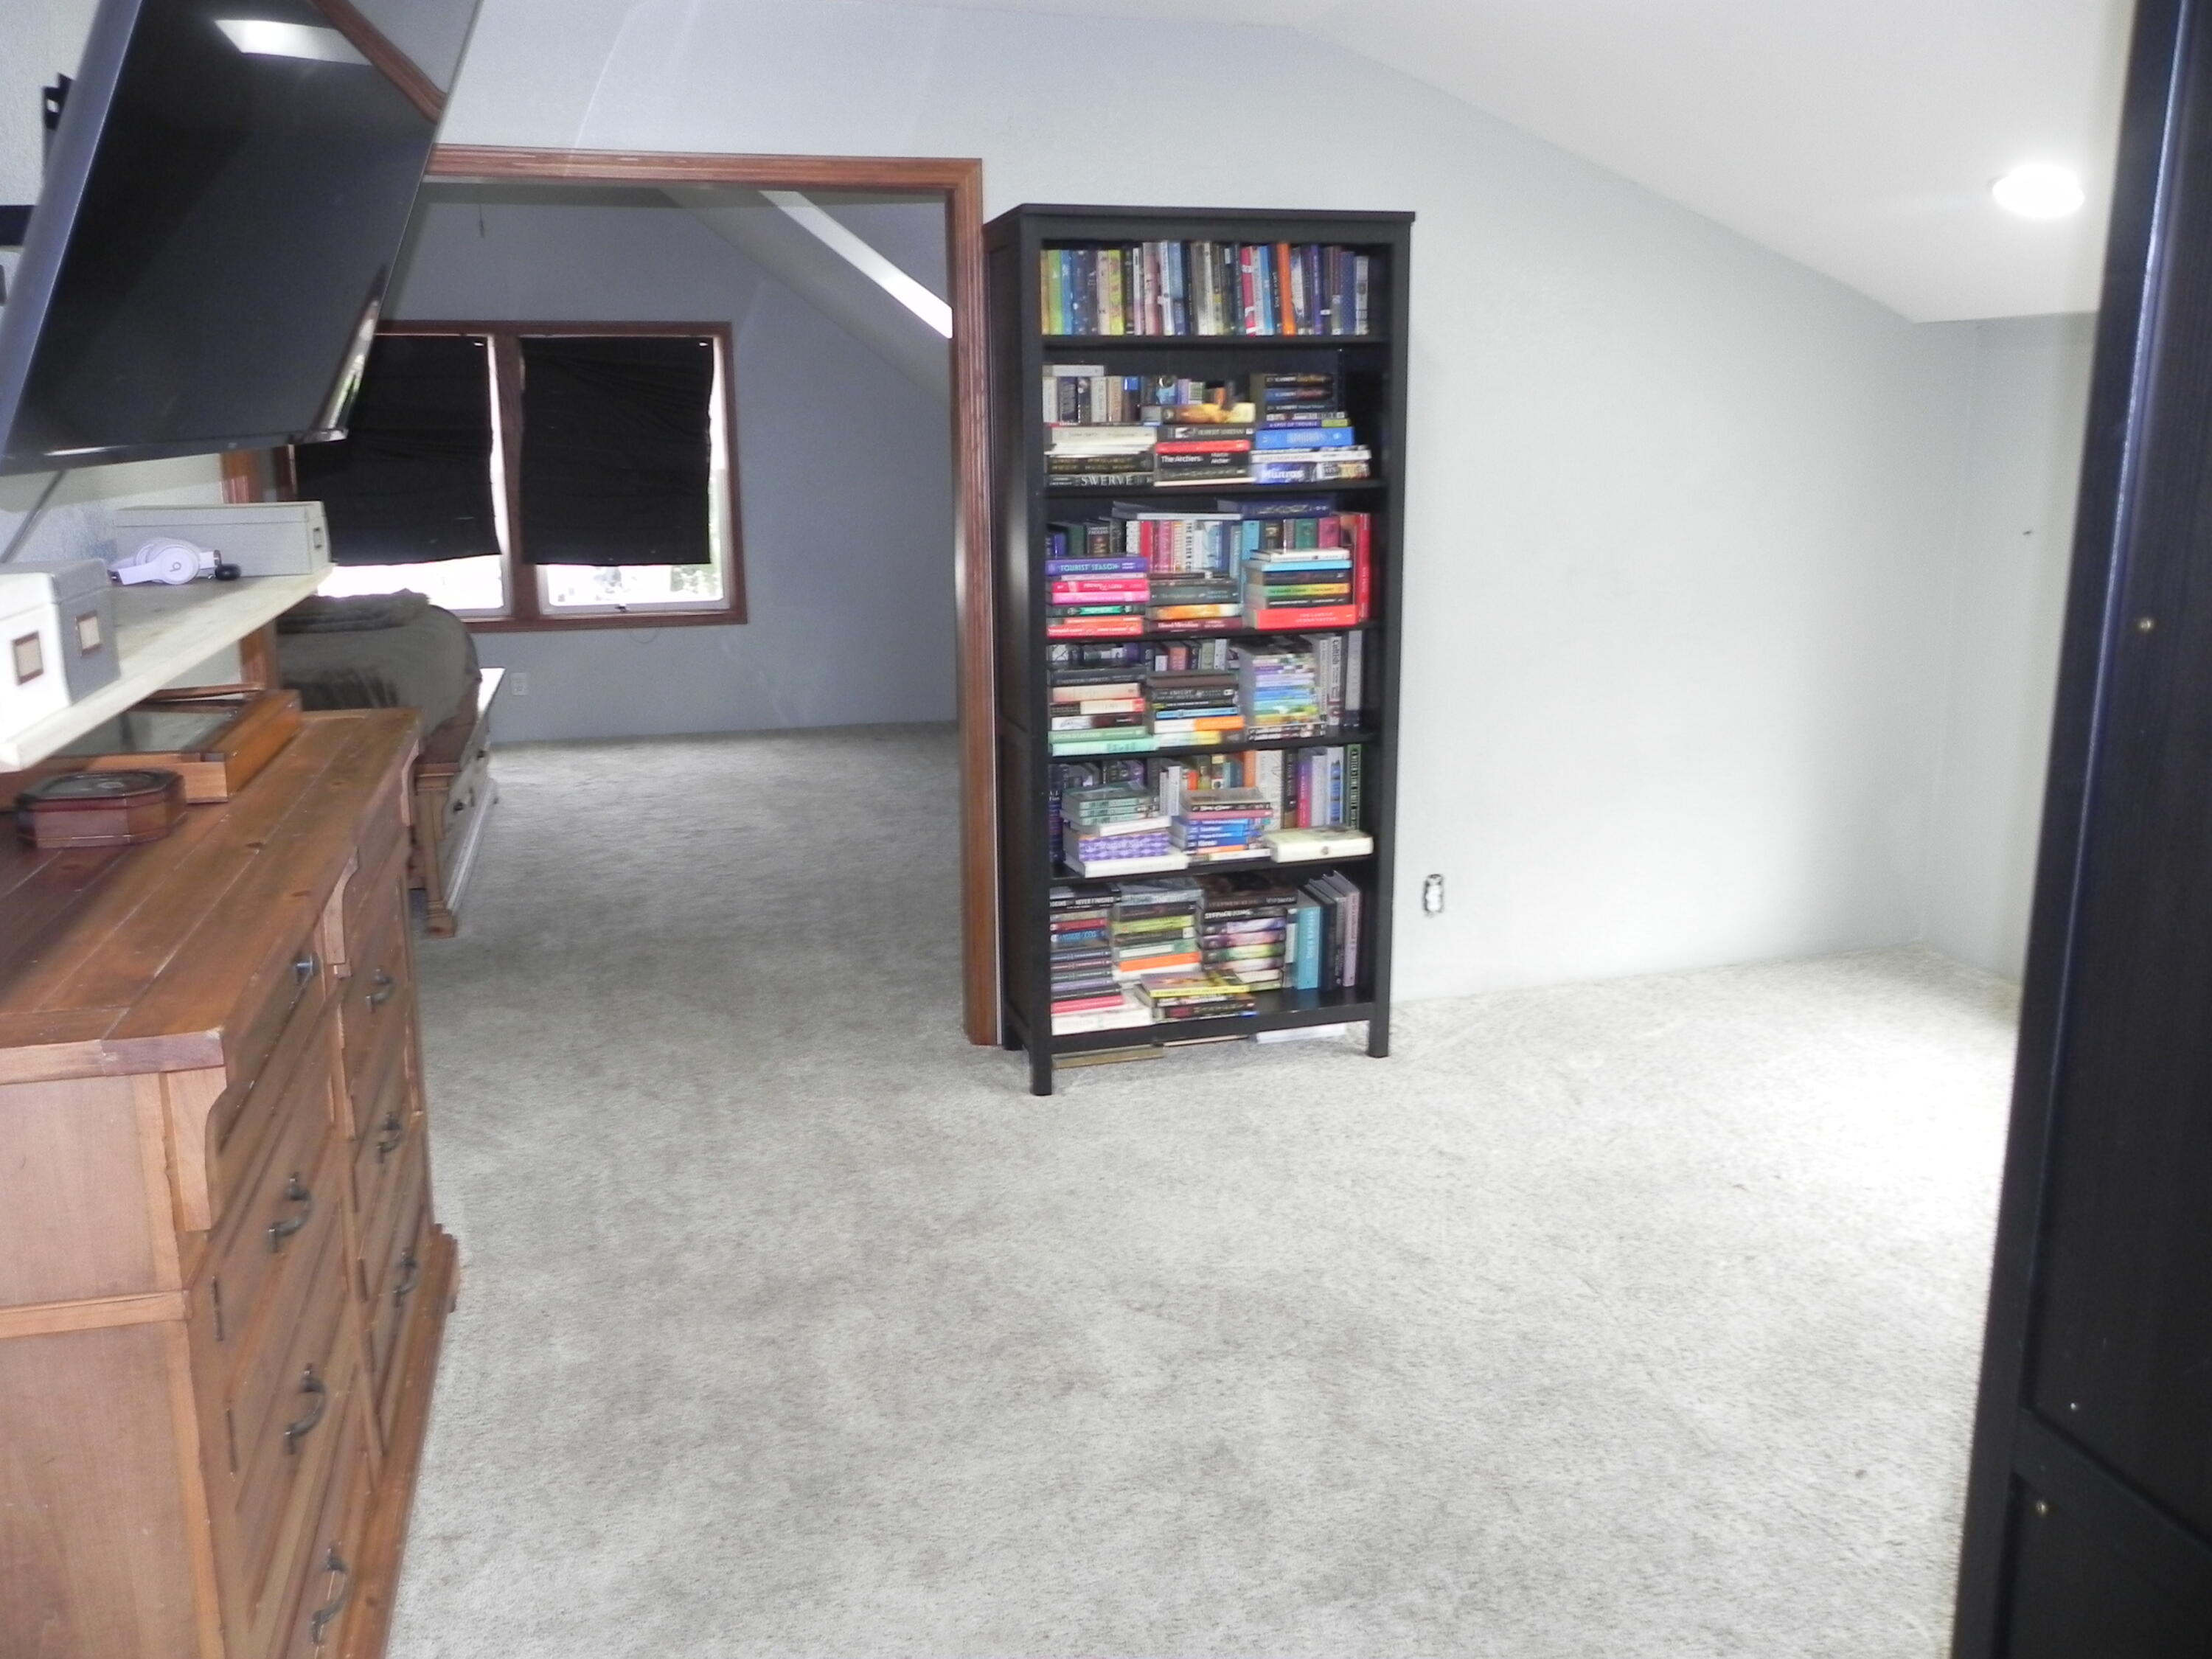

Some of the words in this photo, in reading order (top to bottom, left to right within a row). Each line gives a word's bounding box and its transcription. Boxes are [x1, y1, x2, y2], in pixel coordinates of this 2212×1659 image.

[1080, 474, 1133, 487] SWERVE
[1060, 563, 1089, 572] TOURIST
[1091, 563, 1119, 571] SEASON
